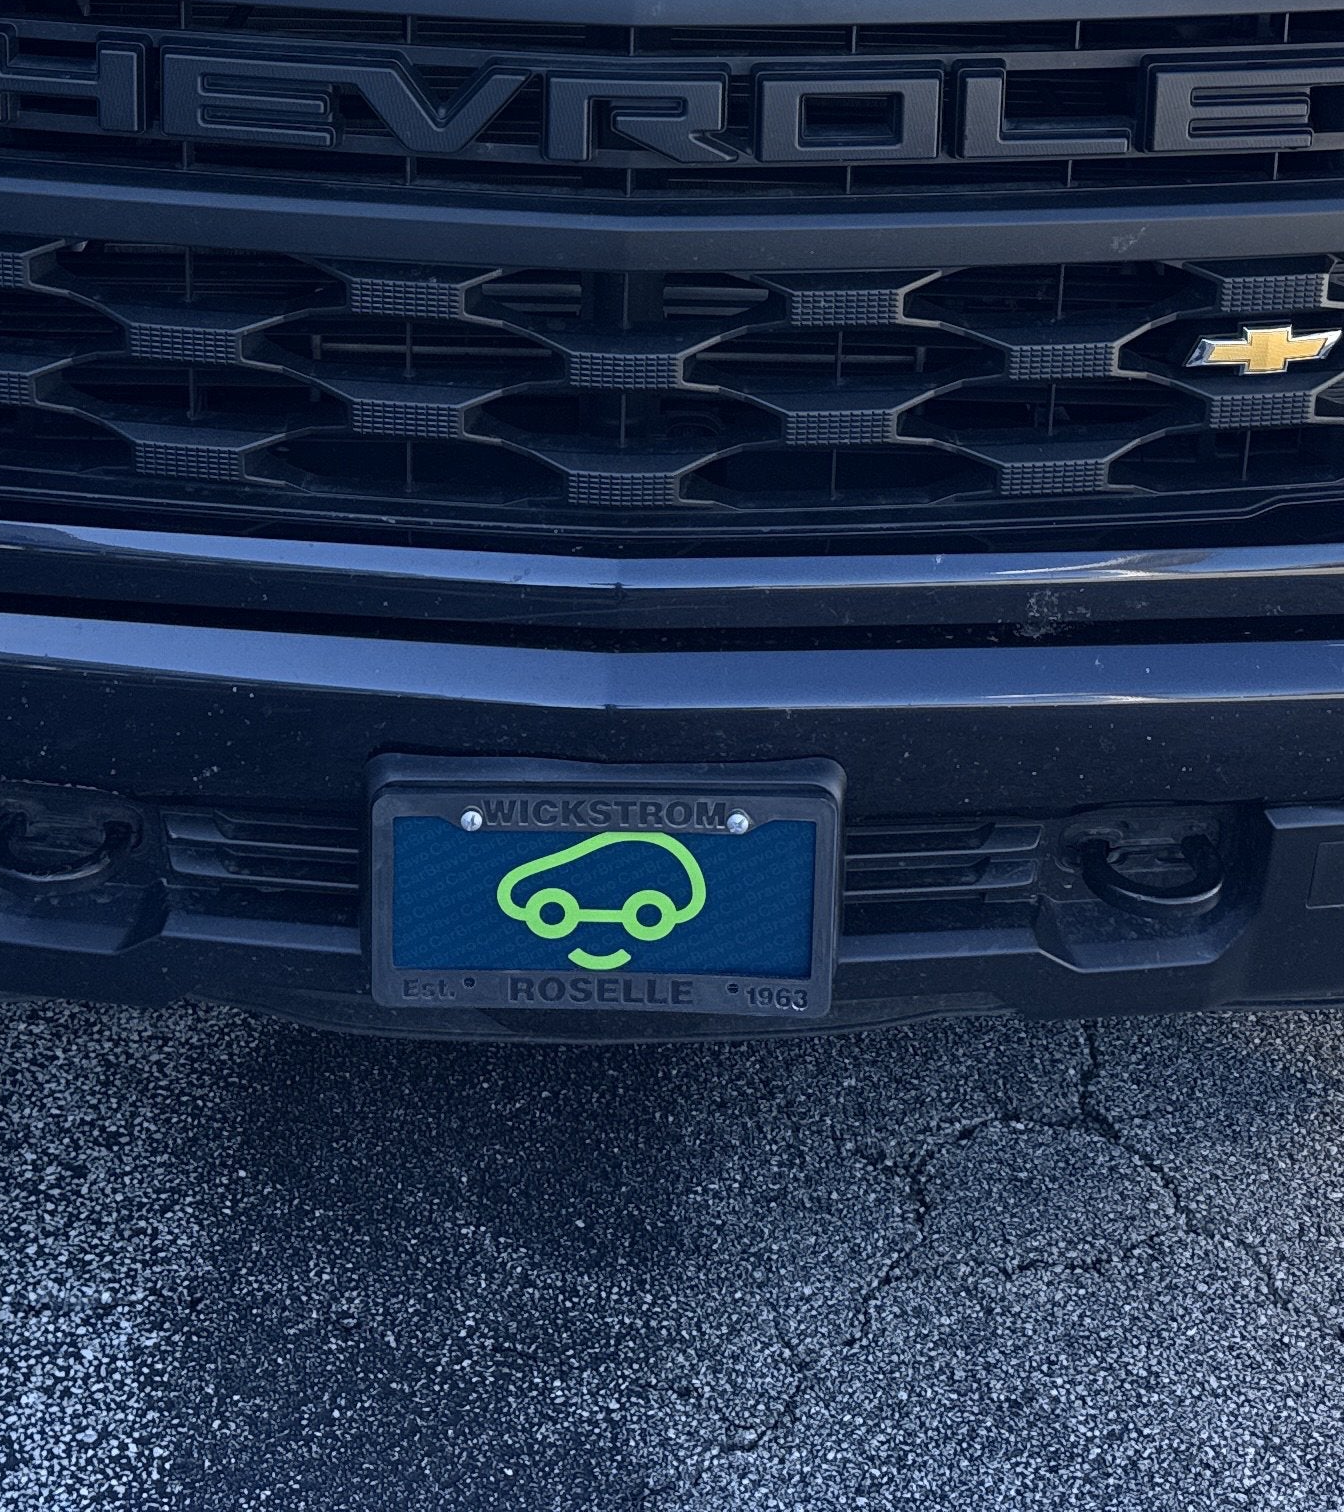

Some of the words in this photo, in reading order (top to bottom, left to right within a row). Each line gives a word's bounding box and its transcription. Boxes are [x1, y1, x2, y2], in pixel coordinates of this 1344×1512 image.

[482, 799, 726, 829] WICKSTROM
[402, 979, 456, 1000] Est.
[508, 976, 694, 1006] ROSELLE
[744, 986, 809, 1011] 1963
